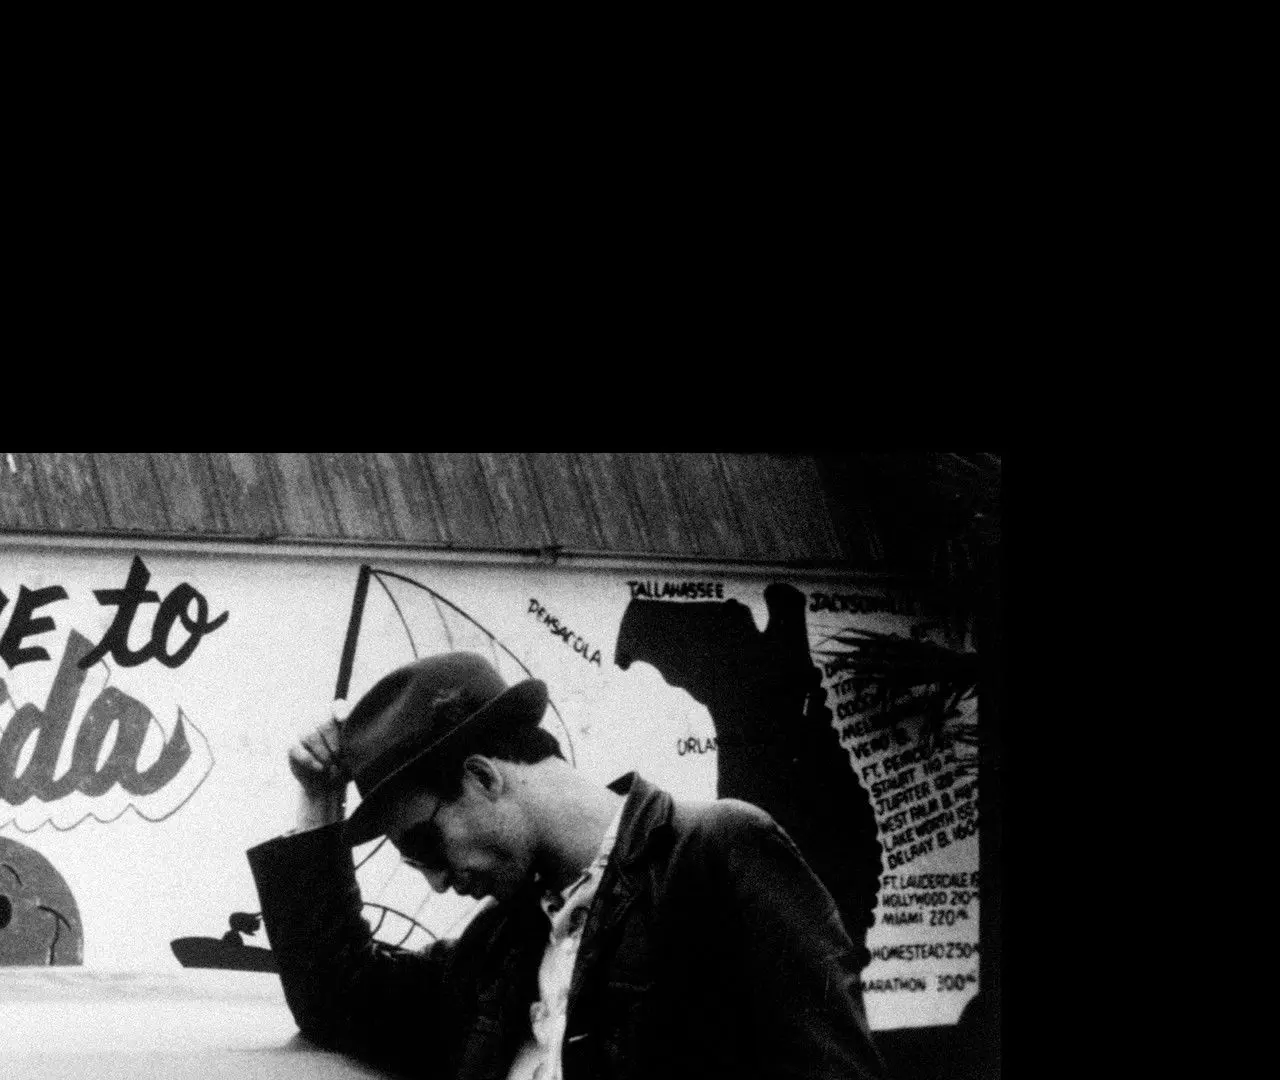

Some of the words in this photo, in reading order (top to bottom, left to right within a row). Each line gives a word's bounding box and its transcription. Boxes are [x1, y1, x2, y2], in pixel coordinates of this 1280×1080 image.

[626, 580, 724, 599] TALLAHASSEE
[76, 554, 229, 669] to
[526, 597, 602, 667] PENSACOLA
[875, 781, 930, 815] JUPITER
[882, 827, 913, 853] LAKE
[887, 838, 933, 870] DELRAY
[899, 872, 968, 889] LAUDERDALE
[882, 891, 947, 908] HOLLYWOOD
[881, 911, 924, 926] MIAMI
[871, 943, 944, 961] HOMESTEAD
